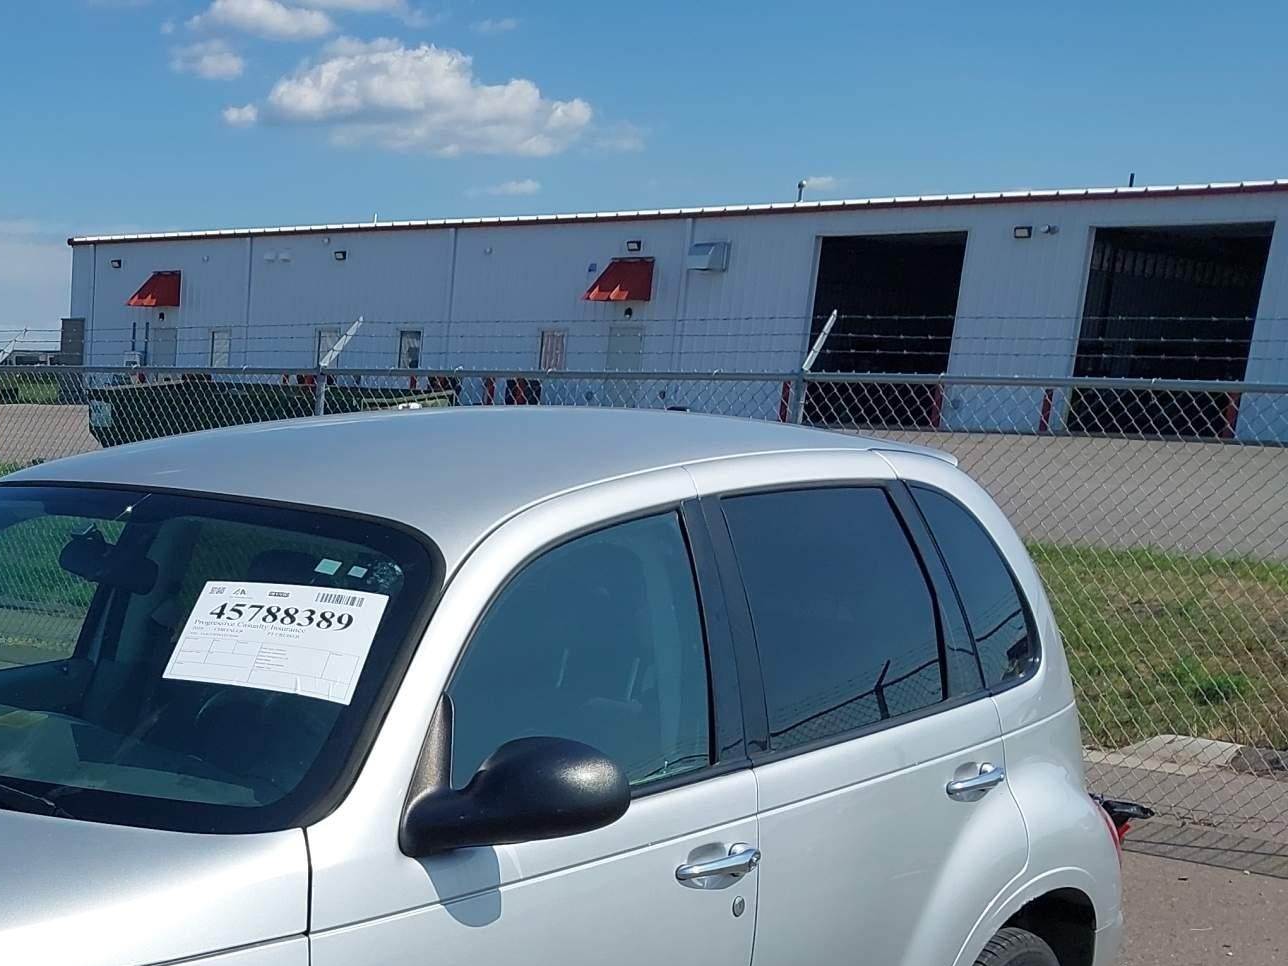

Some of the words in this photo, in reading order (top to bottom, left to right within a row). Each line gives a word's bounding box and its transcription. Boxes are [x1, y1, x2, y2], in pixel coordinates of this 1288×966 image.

[194, 619, 236, 628] Progressive
[237, 622, 268, 631] Casualty
[270, 625, 306, 633] Insurance
[209, 601, 354, 632] 45788389
